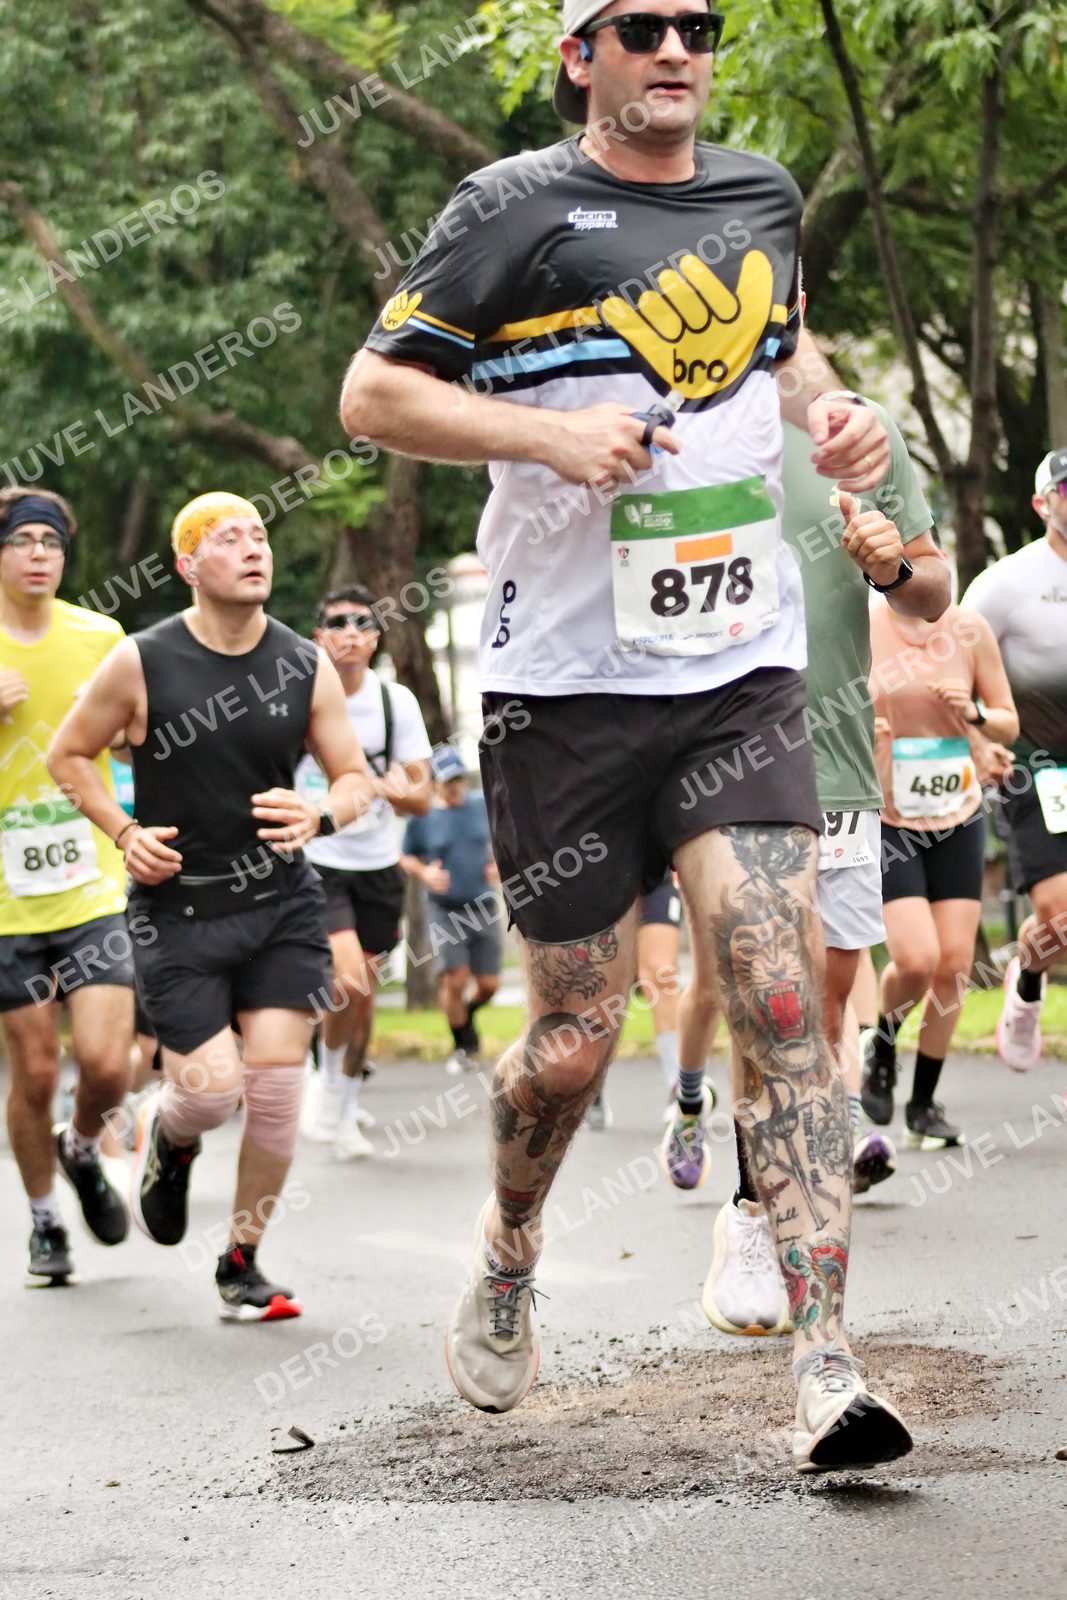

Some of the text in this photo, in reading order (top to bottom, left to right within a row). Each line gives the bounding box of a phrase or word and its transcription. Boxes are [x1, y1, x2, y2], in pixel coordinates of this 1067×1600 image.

[673, 348, 728, 385] bro
[650, 556, 754, 617] 878
[491, 580, 516, 648] bro
[910, 774, 960, 796] 480
[824, 811, 860, 837] 97
[24, 839, 81, 871] 808
